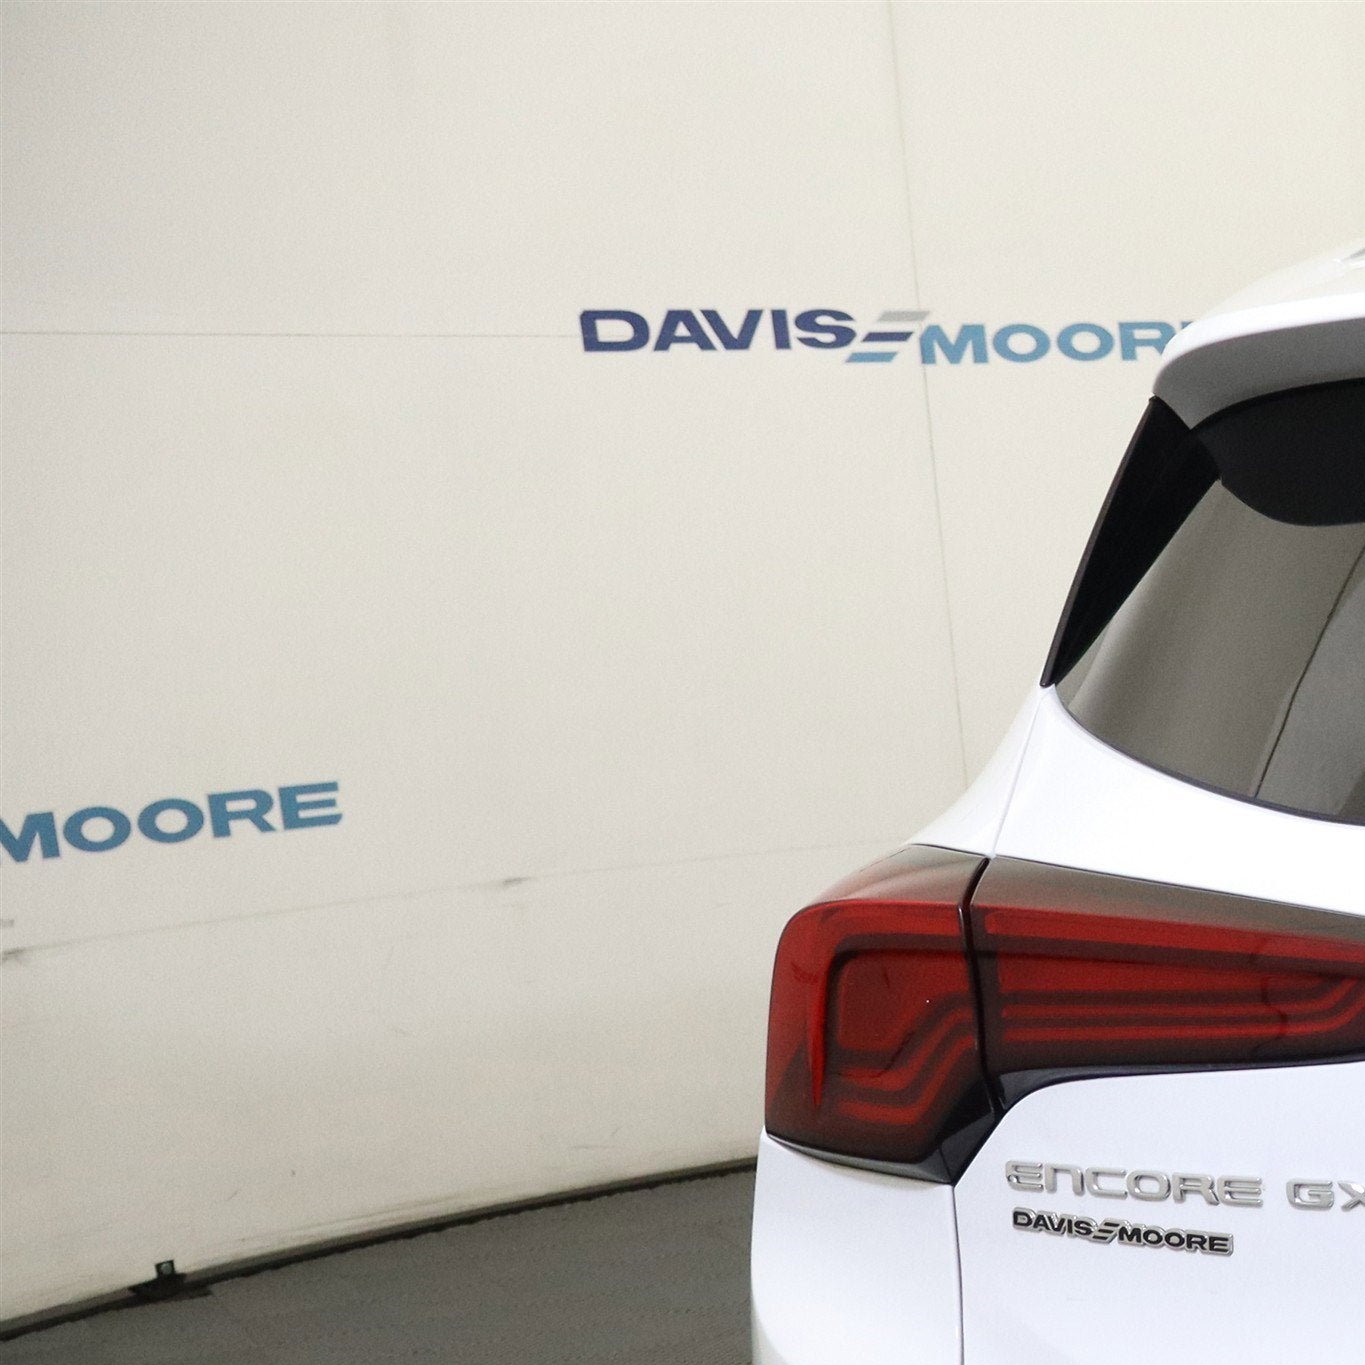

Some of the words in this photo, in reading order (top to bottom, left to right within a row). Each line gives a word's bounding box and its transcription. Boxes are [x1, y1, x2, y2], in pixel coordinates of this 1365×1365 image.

[579, 309, 858, 353] DAVIS
[919, 320, 1195, 364] MOOR
[1005, 1160, 1264, 1207] ENCORE
[1012, 1208, 1095, 1237] DAVIS
[1118, 1224, 1233, 1255] MOORE
